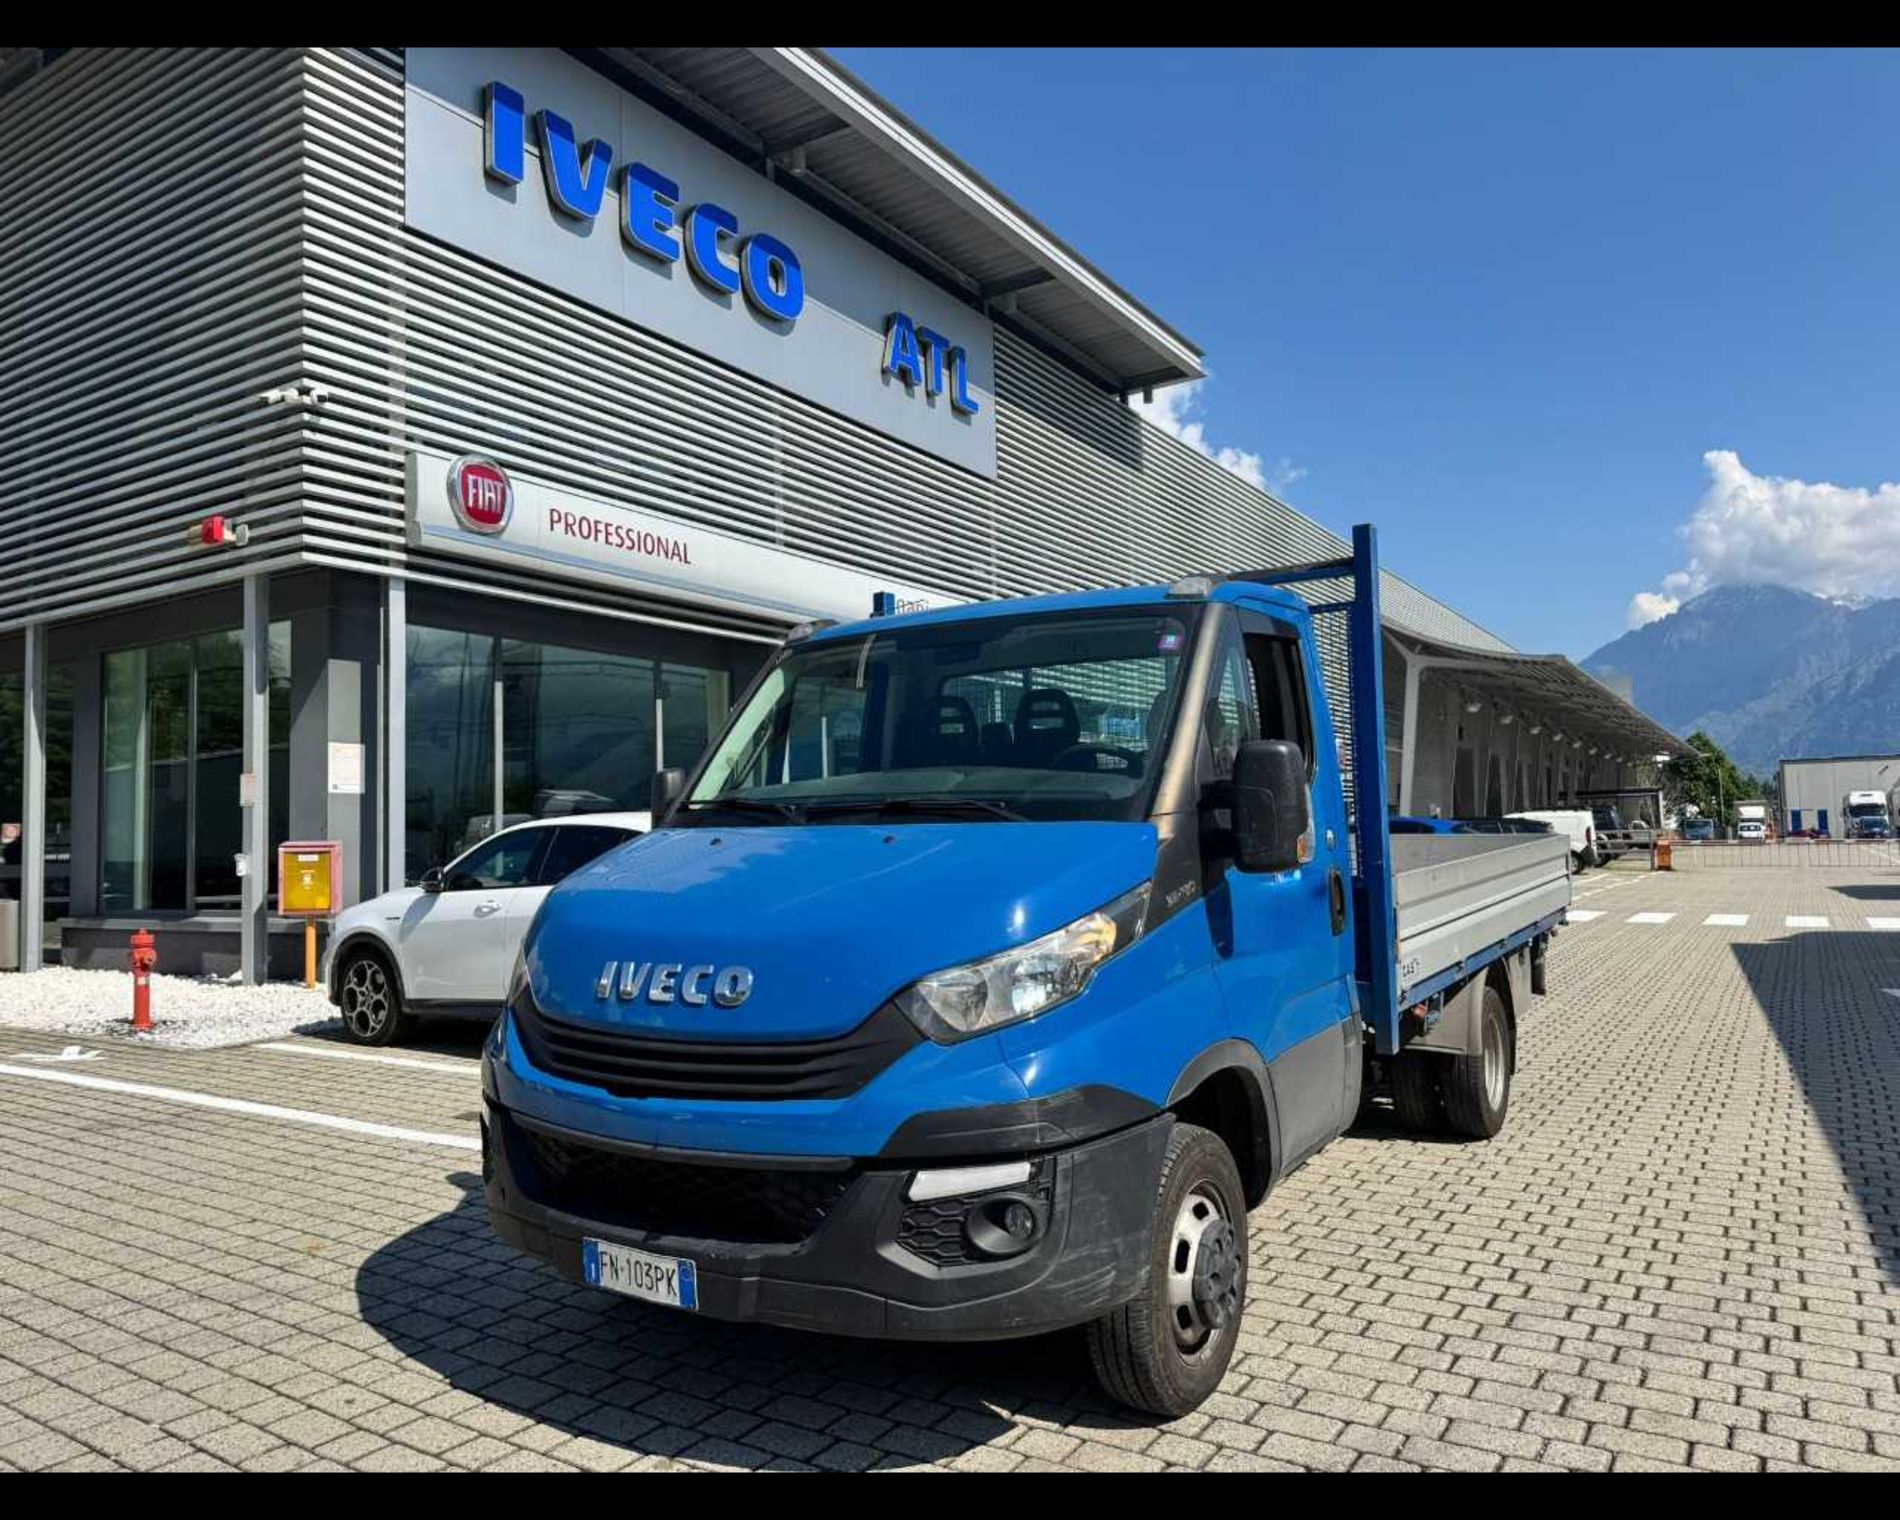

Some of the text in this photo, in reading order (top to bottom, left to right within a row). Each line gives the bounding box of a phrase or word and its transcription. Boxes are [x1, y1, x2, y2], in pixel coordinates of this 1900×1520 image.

[485, 81, 805, 320] IVECO
[882, 311, 979, 415] ATL
[467, 473, 504, 514] FIAT
[549, 507, 692, 565] PROFESSIONAL
[597, 960, 755, 1007] IVECO
